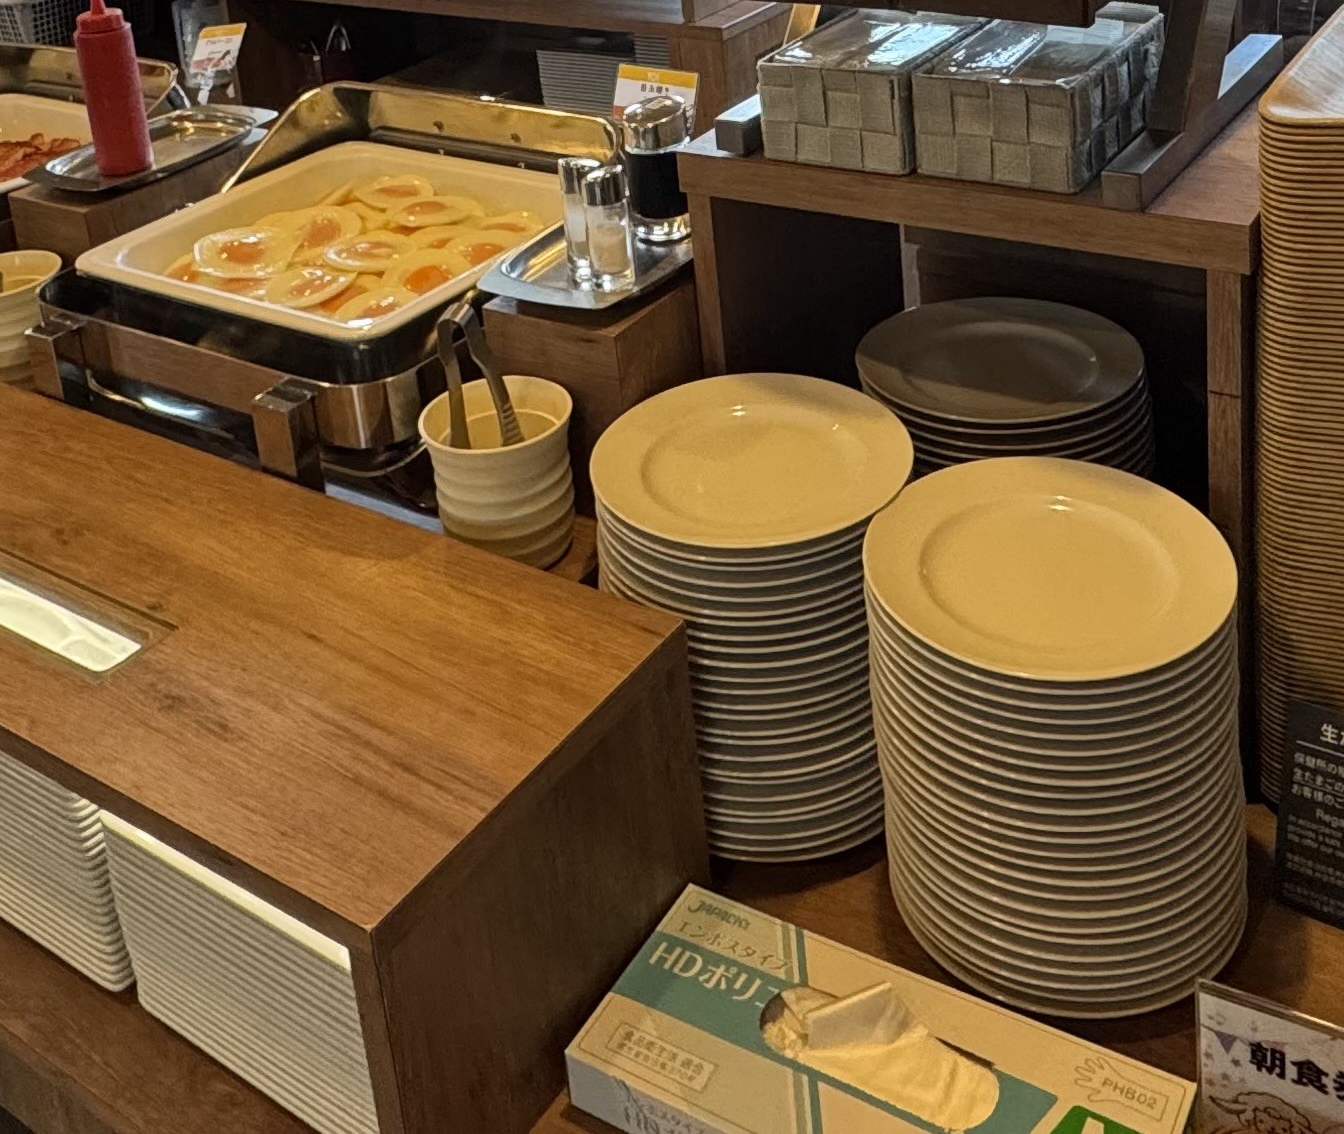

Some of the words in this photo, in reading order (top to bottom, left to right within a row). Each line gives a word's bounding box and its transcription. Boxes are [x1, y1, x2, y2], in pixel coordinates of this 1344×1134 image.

[679, 919, 788, 970] エンボスタイプ
[648, 941, 779, 1008] HDポリ
[1101, 1076, 1158, 1111] PHB02
